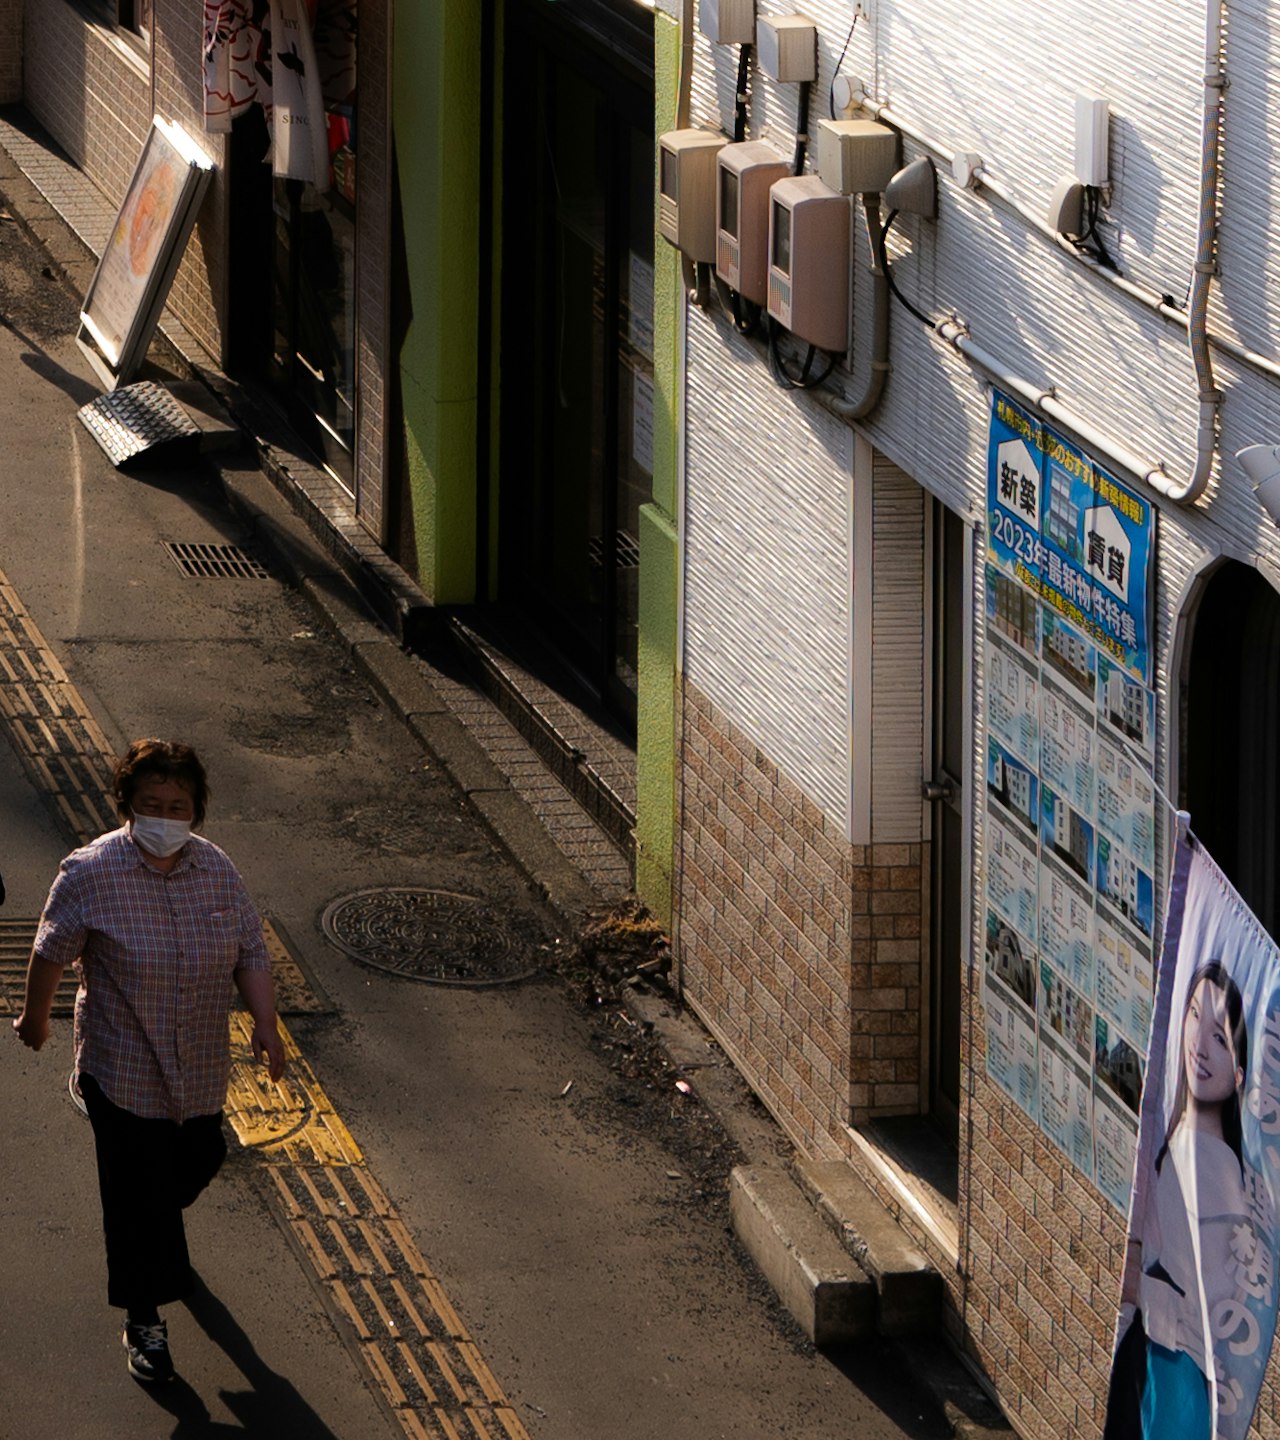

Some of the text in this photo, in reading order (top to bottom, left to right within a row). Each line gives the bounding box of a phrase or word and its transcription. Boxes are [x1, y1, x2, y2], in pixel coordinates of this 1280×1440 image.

[1000, 461, 1038, 519] 新築
[993, 509, 1139, 650] 2023年最新物件特集
[1086, 528, 1128, 596] 賃貸
